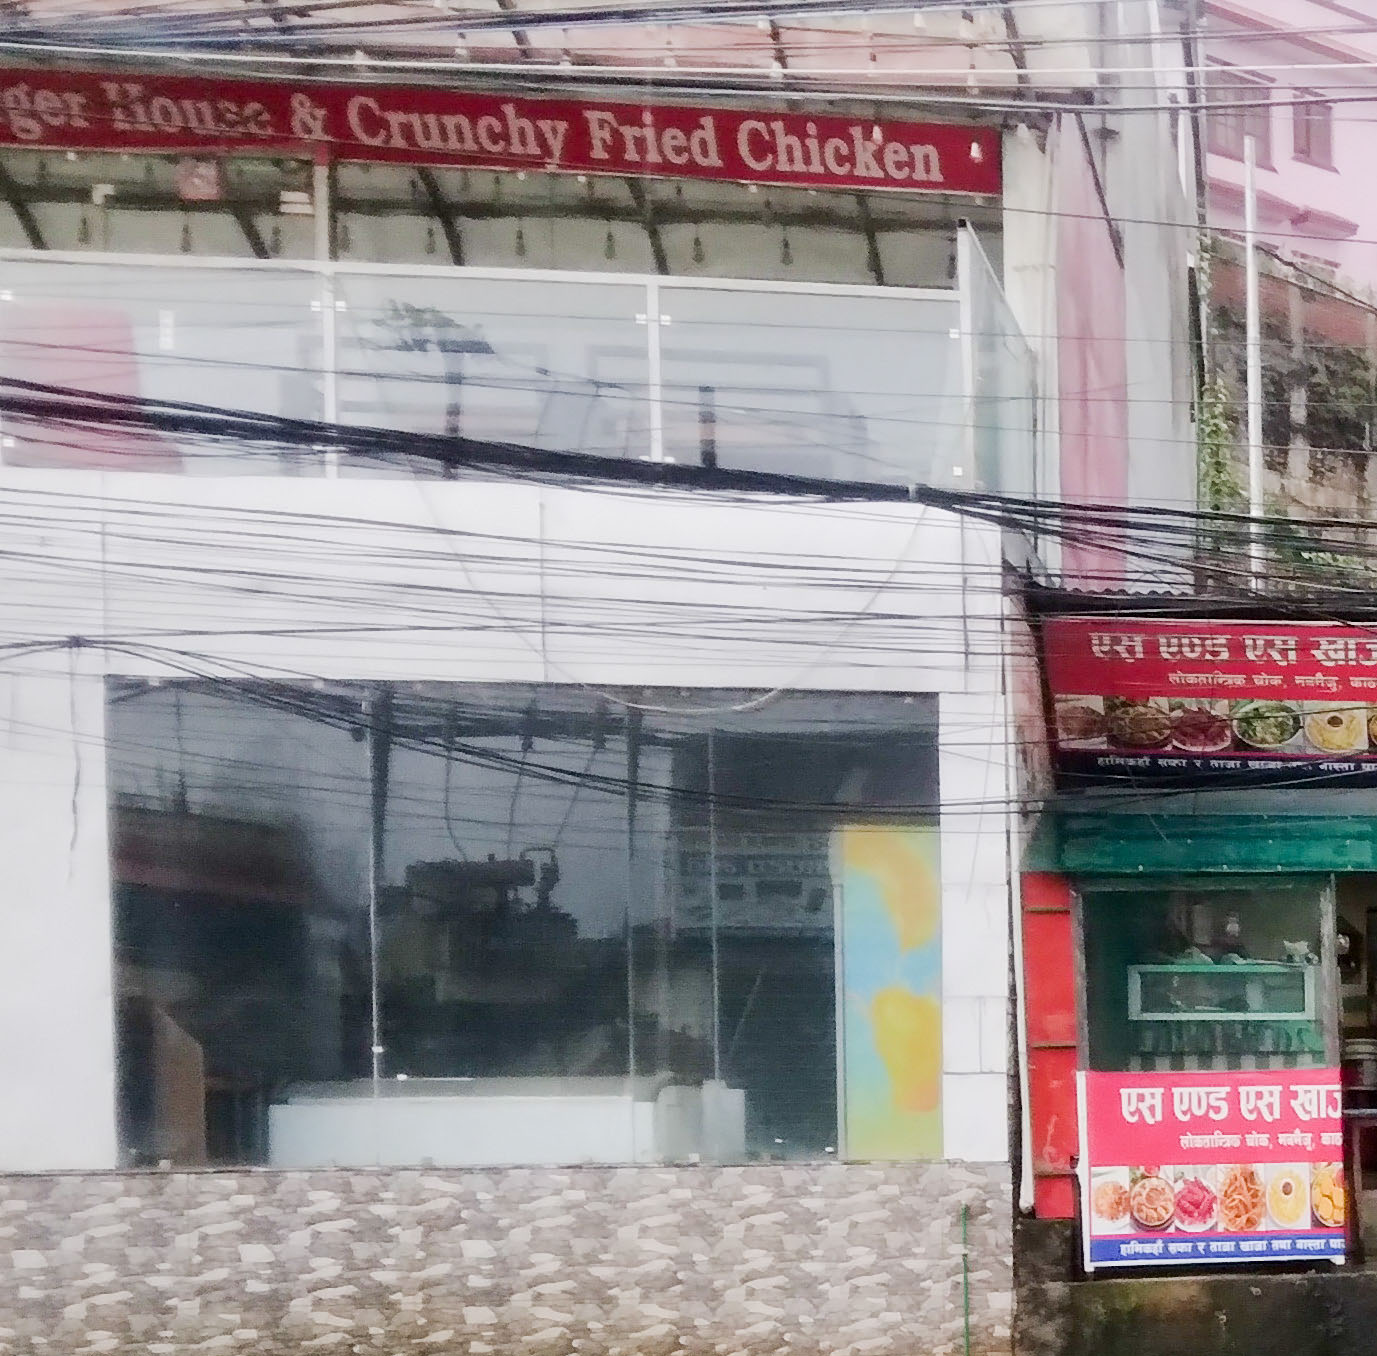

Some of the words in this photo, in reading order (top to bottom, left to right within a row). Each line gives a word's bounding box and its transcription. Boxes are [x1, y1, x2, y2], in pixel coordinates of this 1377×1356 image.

[290, 92, 332, 141] &
[347, 95, 569, 173] Crunchy
[582, 108, 723, 168] Fried
[736, 118, 945, 182] Chicken
[1242, 634, 1299, 666] एस
[1119, 1087, 1165, 1124] एस
[1171, 1086, 1231, 1121] एण्ड
[1238, 1085, 1283, 1122] एस
